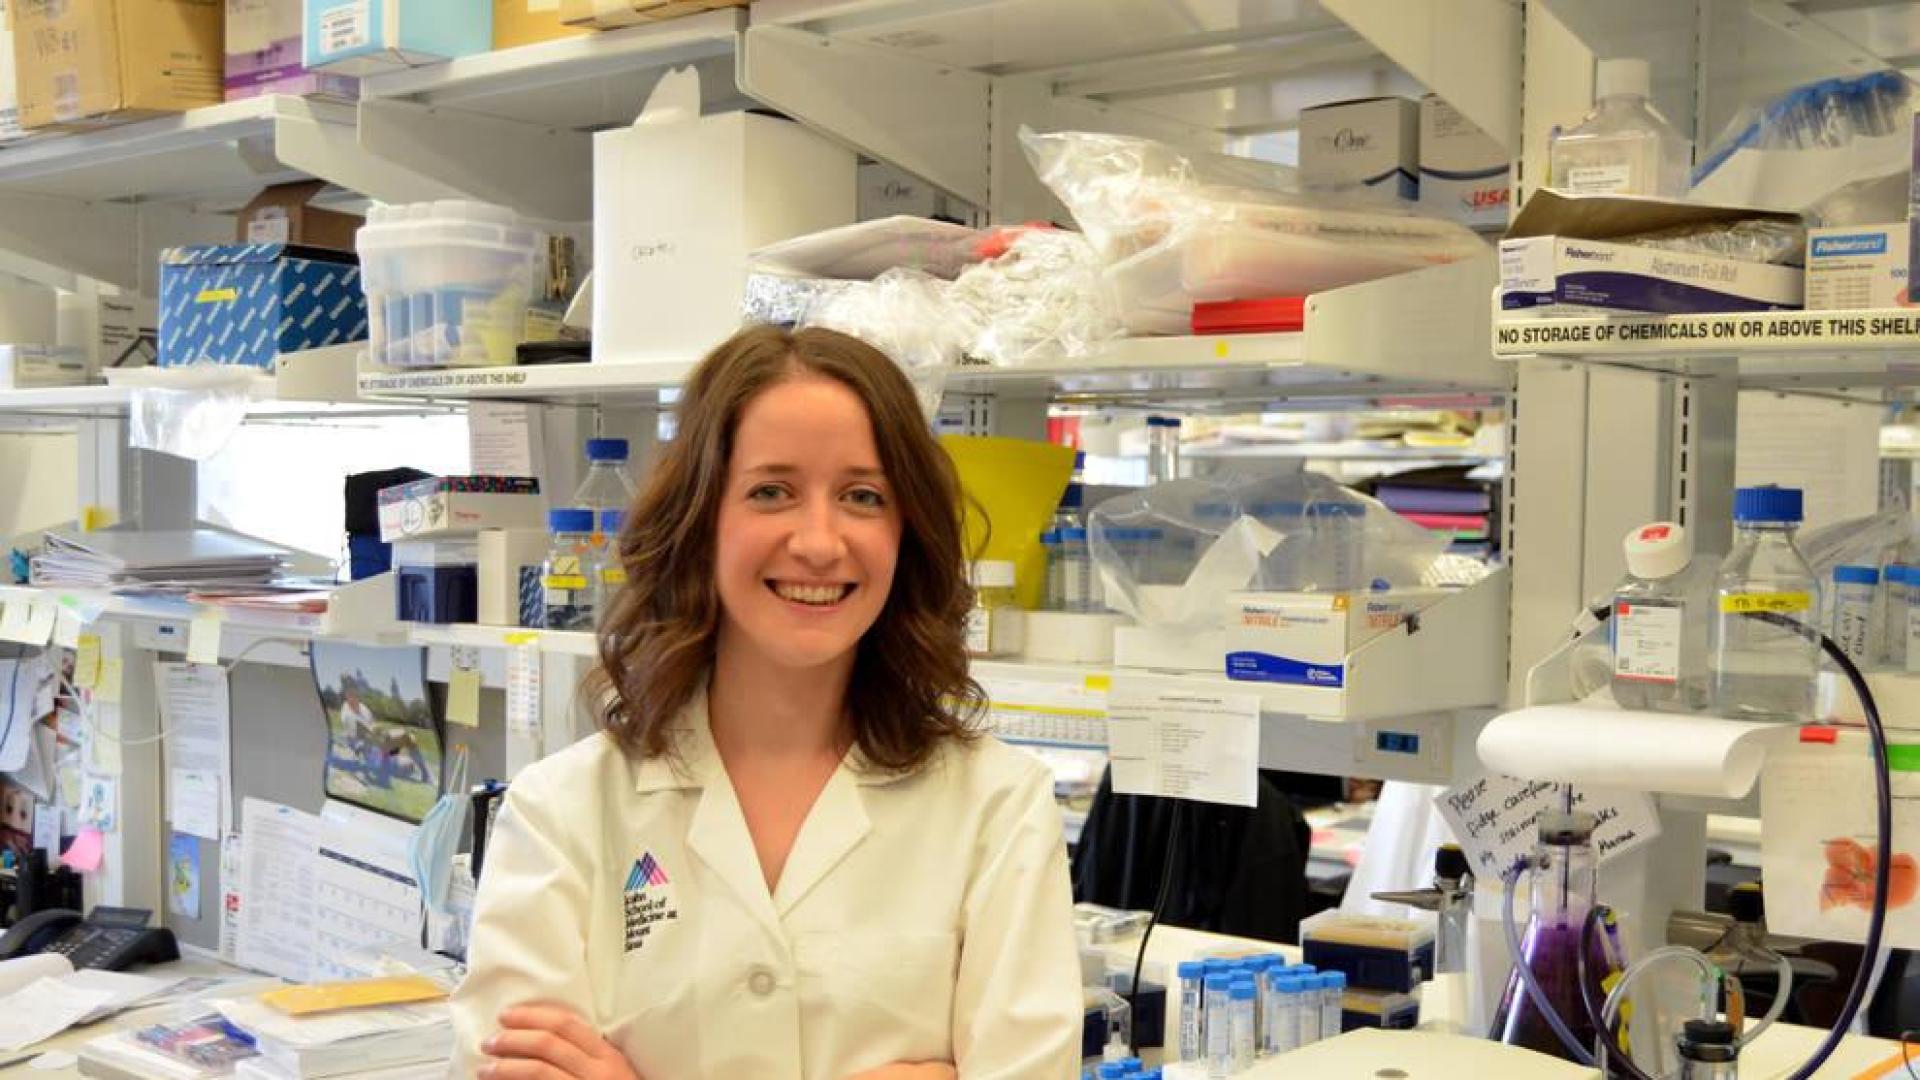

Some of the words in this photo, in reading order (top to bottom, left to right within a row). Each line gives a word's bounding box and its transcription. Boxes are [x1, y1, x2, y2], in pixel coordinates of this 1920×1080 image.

[1498, 328, 1519, 344] NO
[1523, 325, 1591, 343] STORAGE
[1595, 325, 1615, 340] OF
[1619, 322, 1708, 340] CHEMICALS
[1712, 321, 1735, 338] ON
[1740, 321, 1763, 338] OR
[1768, 319, 1823, 336] ABOVE
[1829, 319, 1866, 336] THIS
